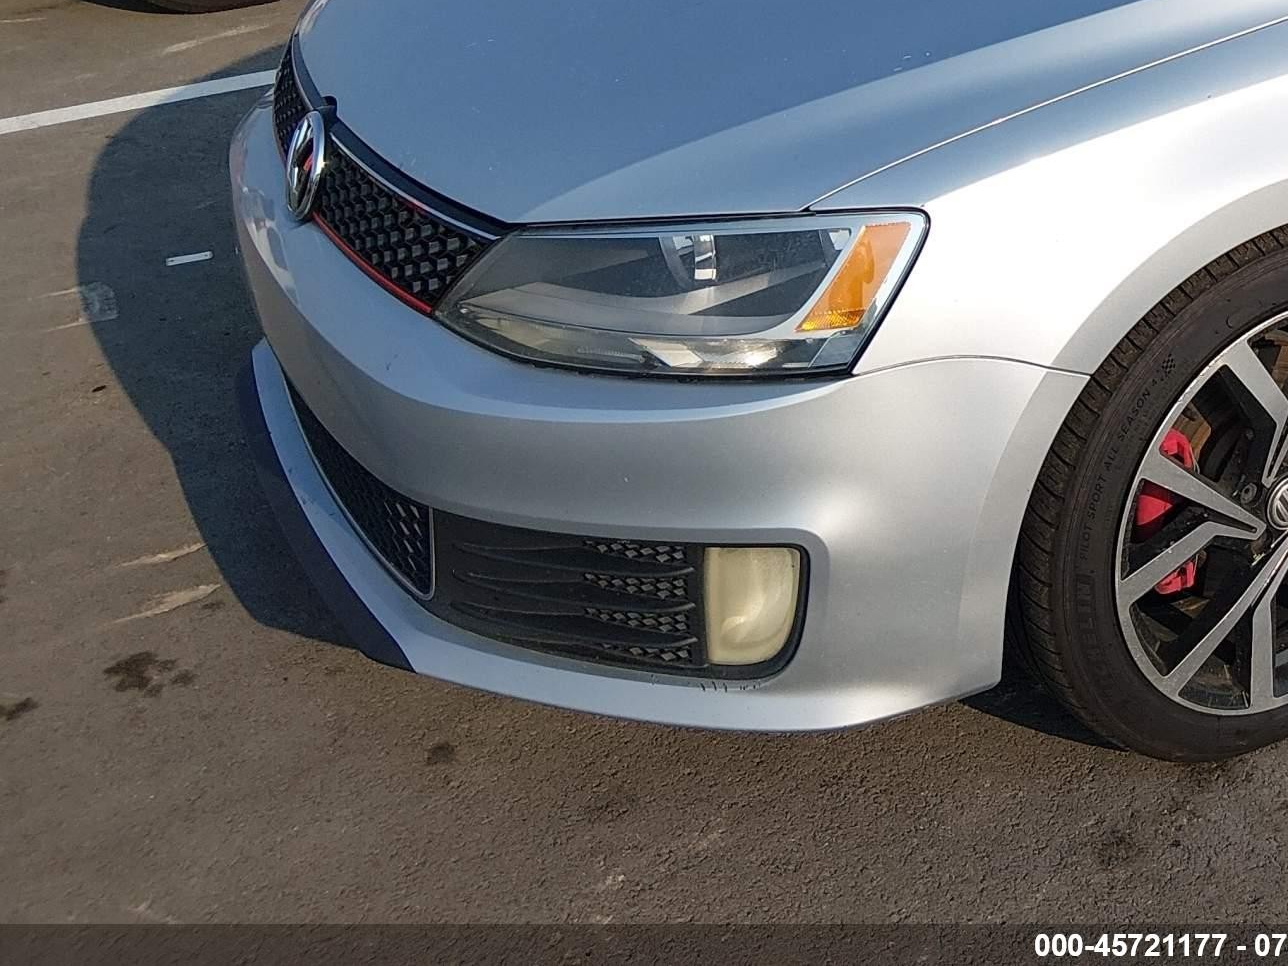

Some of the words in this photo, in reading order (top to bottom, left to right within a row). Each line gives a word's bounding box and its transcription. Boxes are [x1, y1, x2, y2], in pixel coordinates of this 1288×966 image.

[1087, 475, 1107, 521] SPORT
[1103, 446, 1120, 472] ALL
[1117, 387, 1151, 443] SEASON
